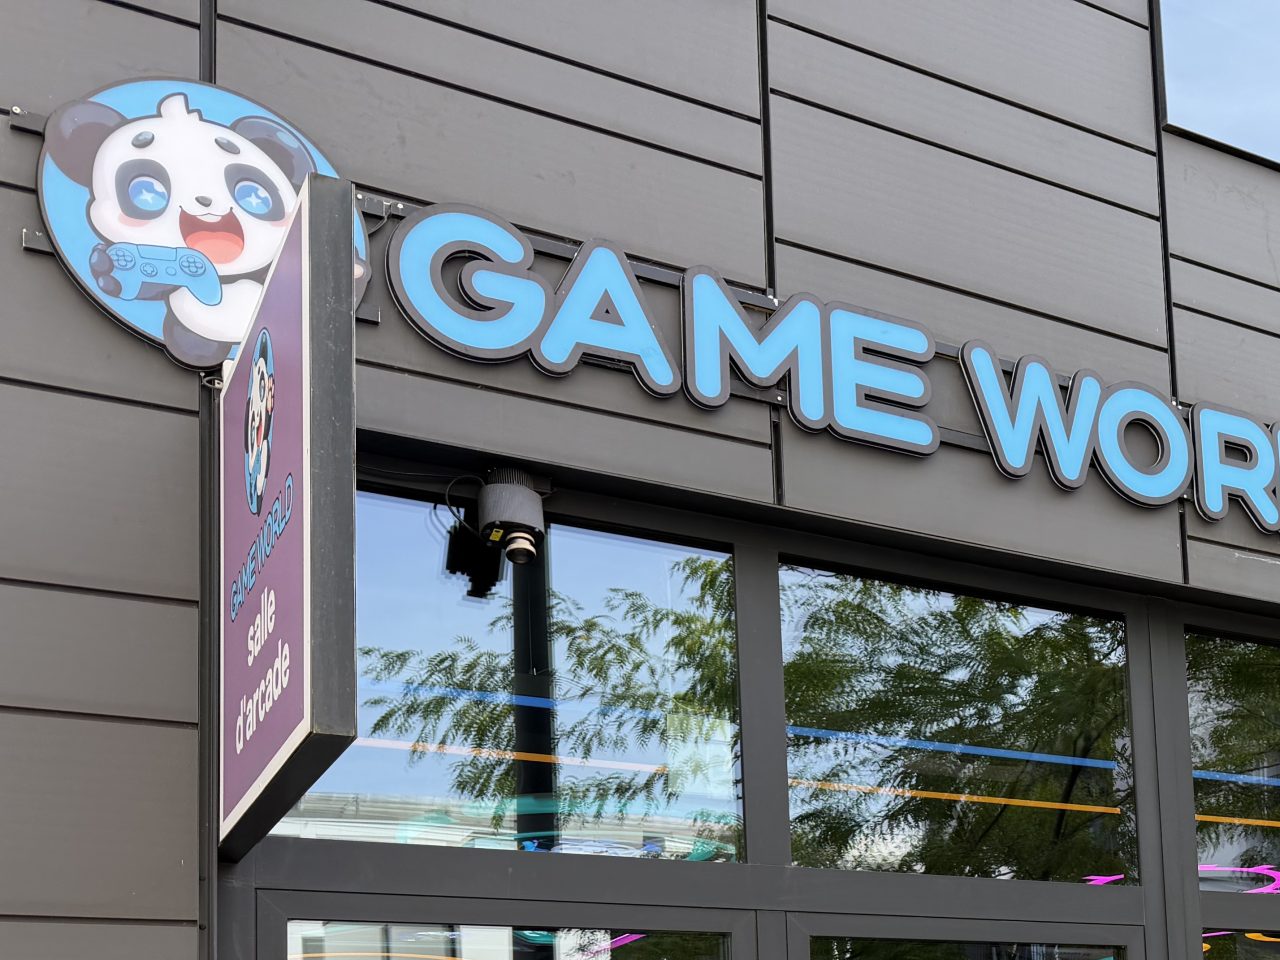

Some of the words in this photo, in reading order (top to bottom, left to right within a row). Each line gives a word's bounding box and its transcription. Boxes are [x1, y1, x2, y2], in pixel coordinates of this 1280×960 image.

[390, 205, 939, 456] GAME
[230, 547, 256, 622] GAME
[257, 472, 293, 568] WORLD
[247, 587, 276, 667] salle
[236, 639, 290, 754] d'arcade
